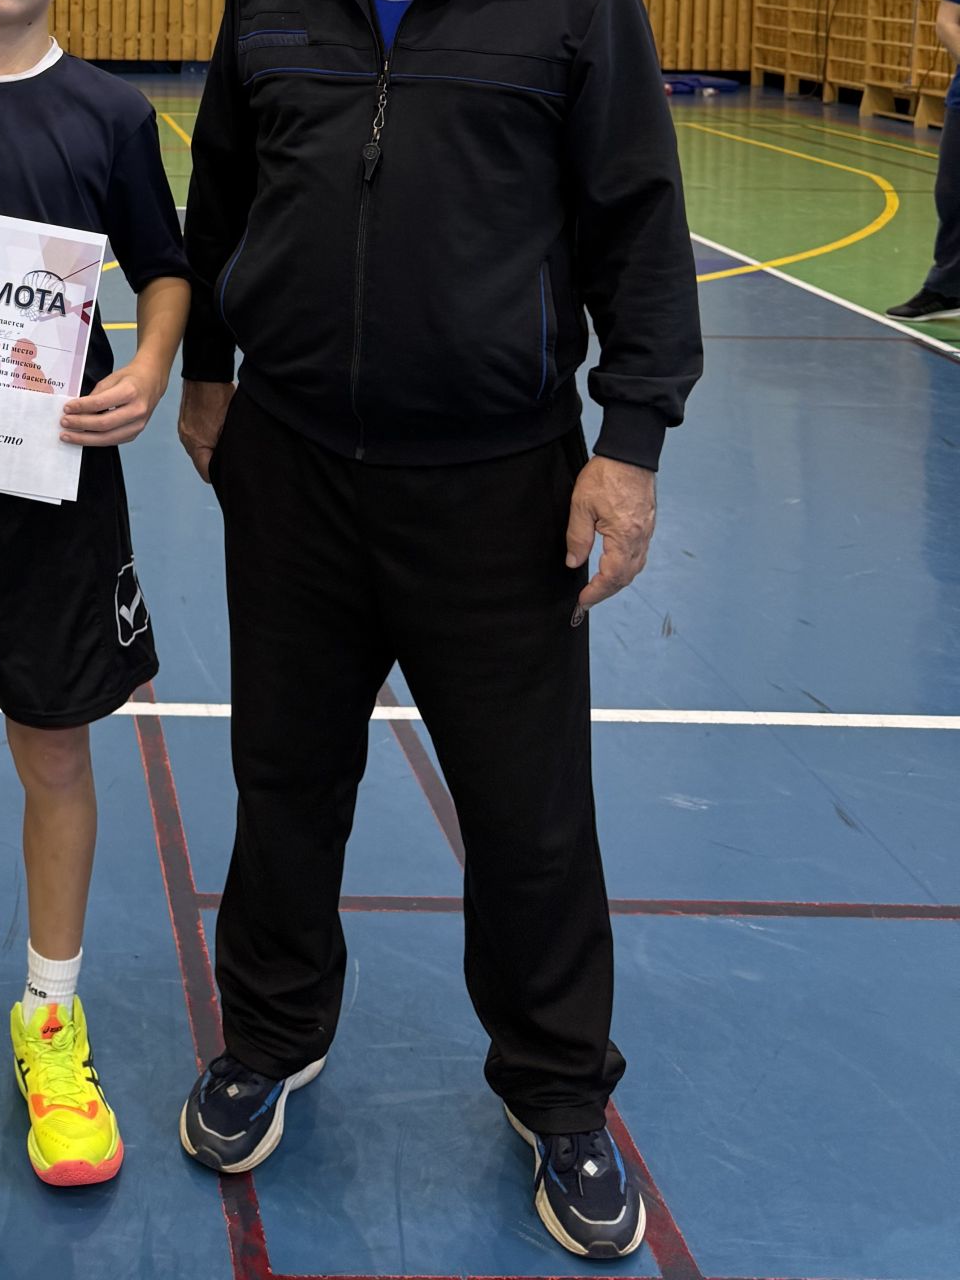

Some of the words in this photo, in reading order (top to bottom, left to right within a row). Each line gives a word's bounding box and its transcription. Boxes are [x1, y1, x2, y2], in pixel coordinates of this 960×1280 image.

[11, 345, 34, 356] место
[10, 371, 20, 379] по
[21, 372, 66, 389] баскетболу
